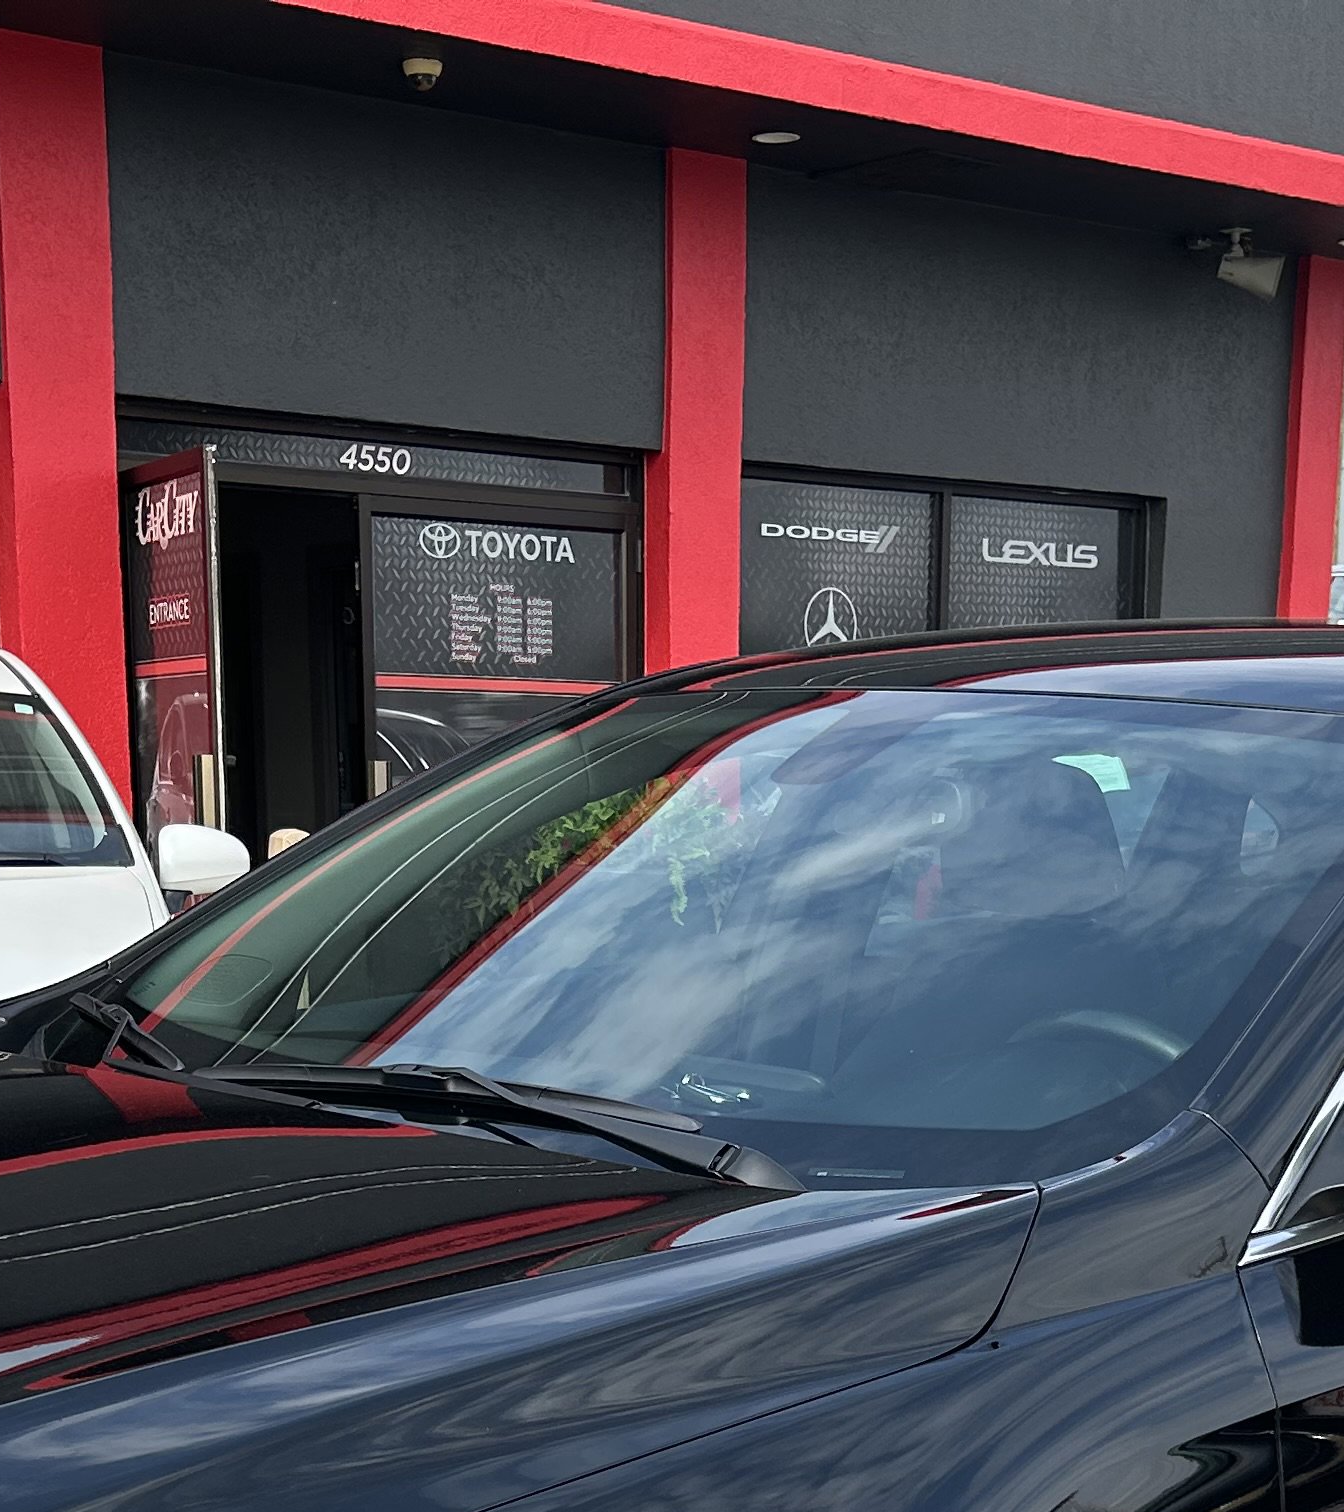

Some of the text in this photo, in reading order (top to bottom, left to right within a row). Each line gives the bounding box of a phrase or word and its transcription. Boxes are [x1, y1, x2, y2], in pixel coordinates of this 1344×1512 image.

[339, 443, 412, 475] 4550
[464, 528, 576, 564] TOYOTA
[761, 522, 881, 546] DODGE
[981, 536, 1099, 569] LEXUS
[149, 598, 190, 625] ENTRANCE
